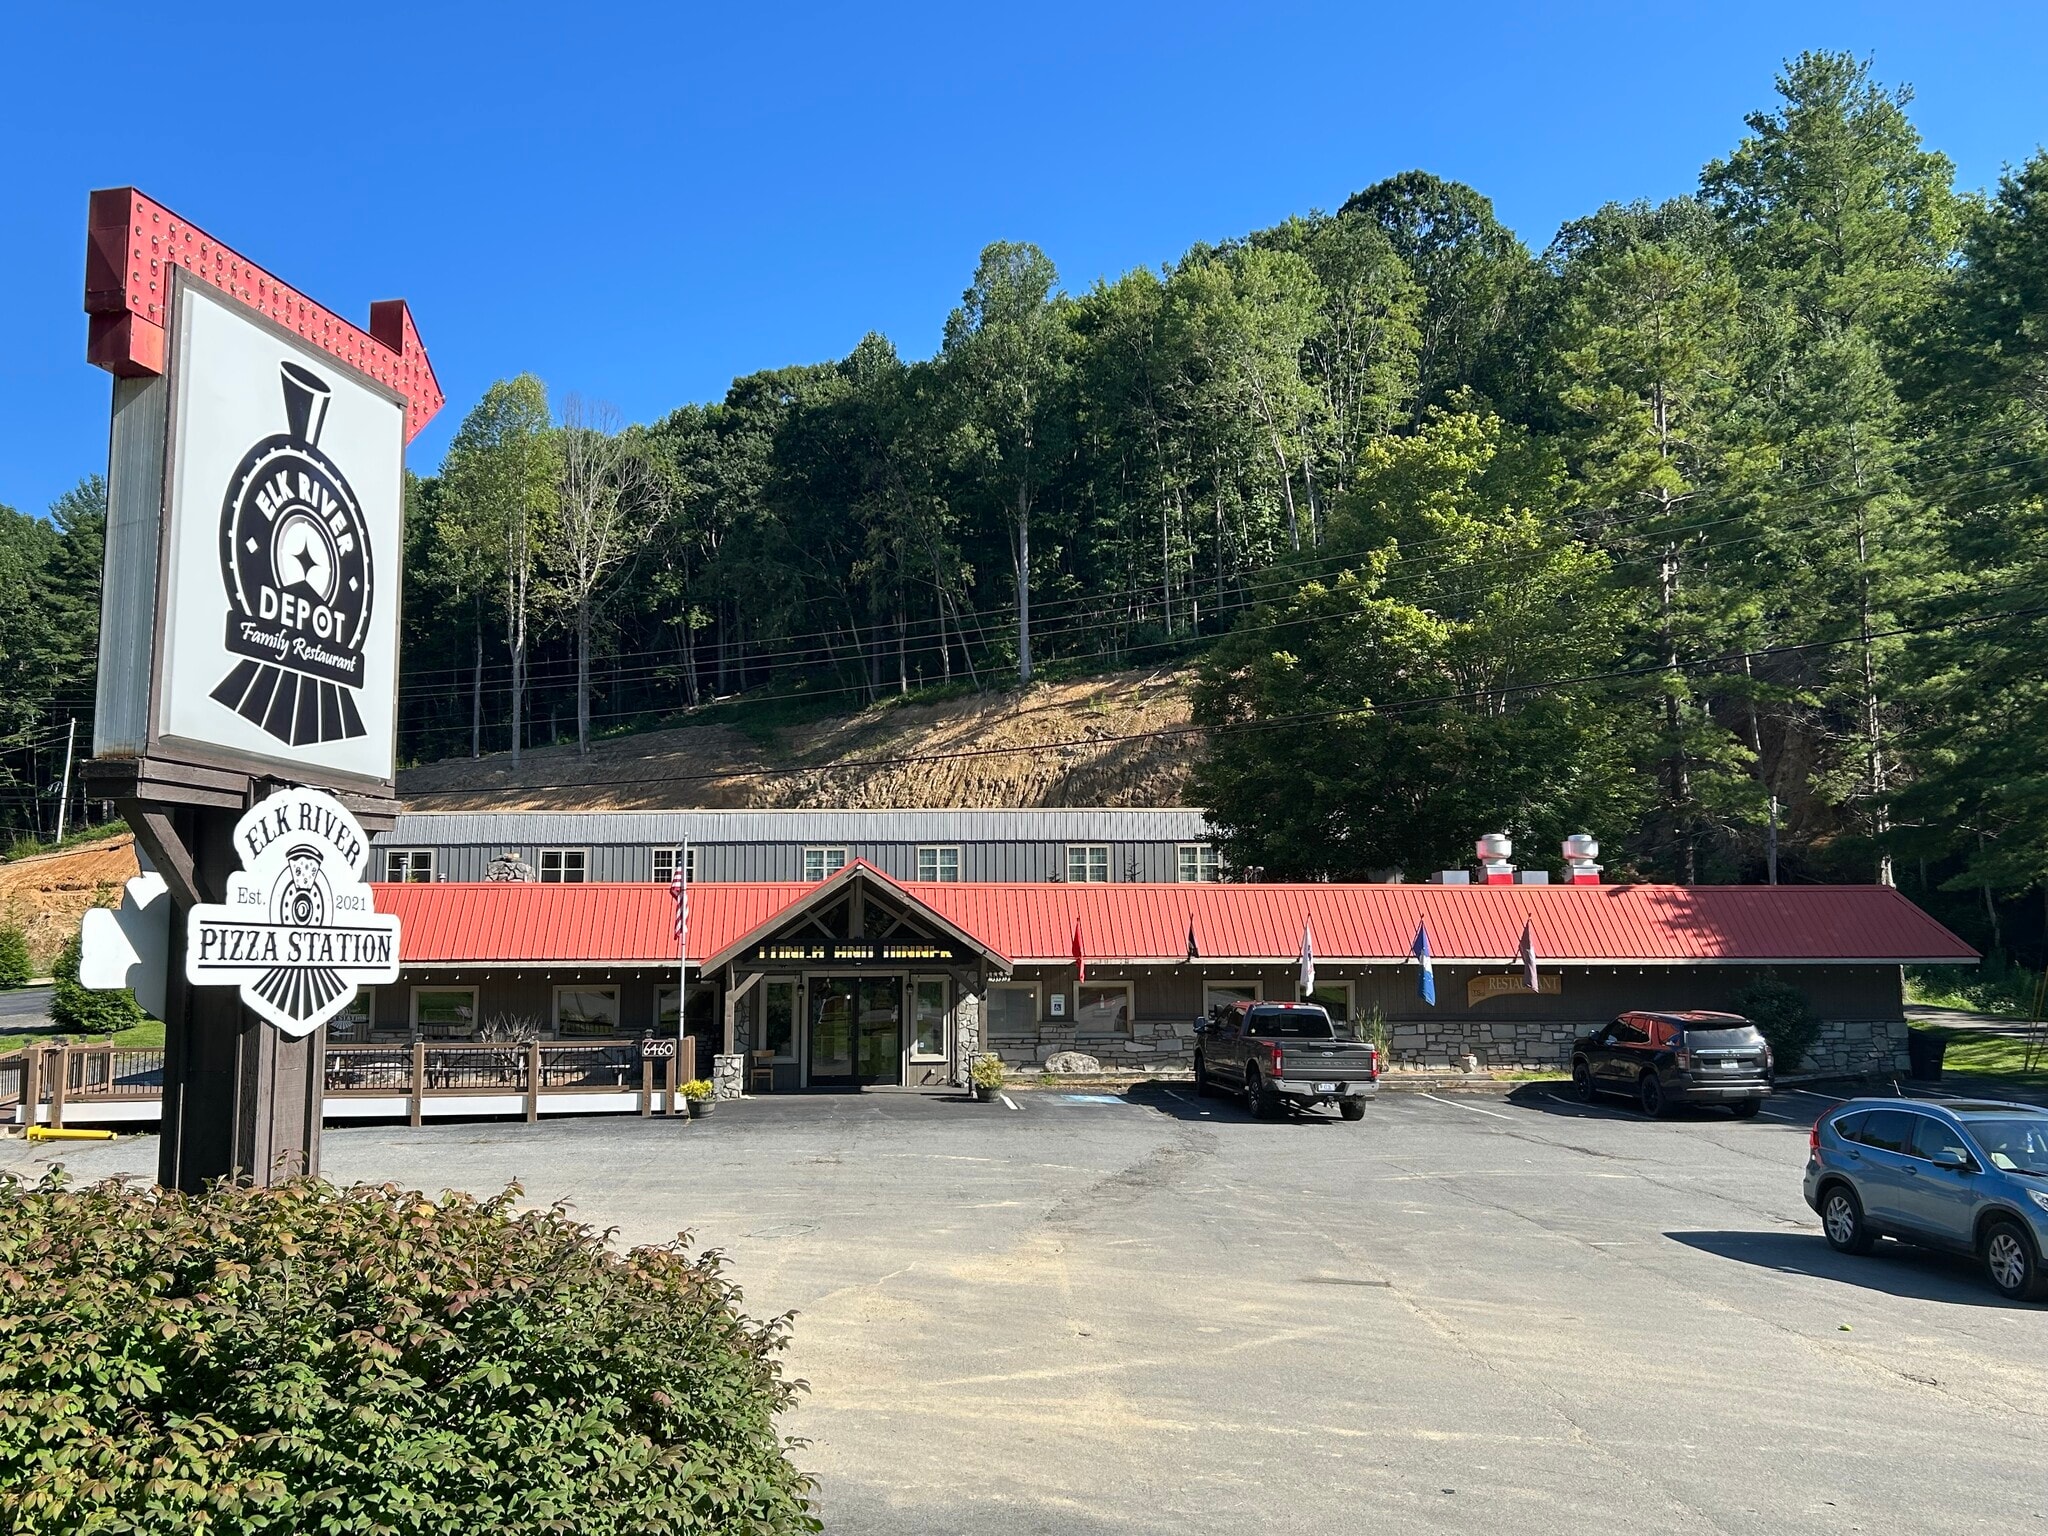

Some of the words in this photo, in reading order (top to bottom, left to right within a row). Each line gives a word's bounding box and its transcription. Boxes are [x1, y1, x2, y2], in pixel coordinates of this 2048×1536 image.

[255, 469, 296, 522] ELK
[298, 472, 354, 556] RIVER
[259, 584, 346, 643] DEPOT
[240, 622, 290, 661] Family
[292, 637, 357, 672] Restaurant
[244, 804, 292, 860] ELK
[298, 802, 362, 870] RIVER
[236, 886, 266, 906] Est.
[335, 895, 367, 911] 2021
[198, 928, 279, 962] PIZZA
[287, 930, 393, 963] STATION
[643, 1041, 674, 1056] 6460
